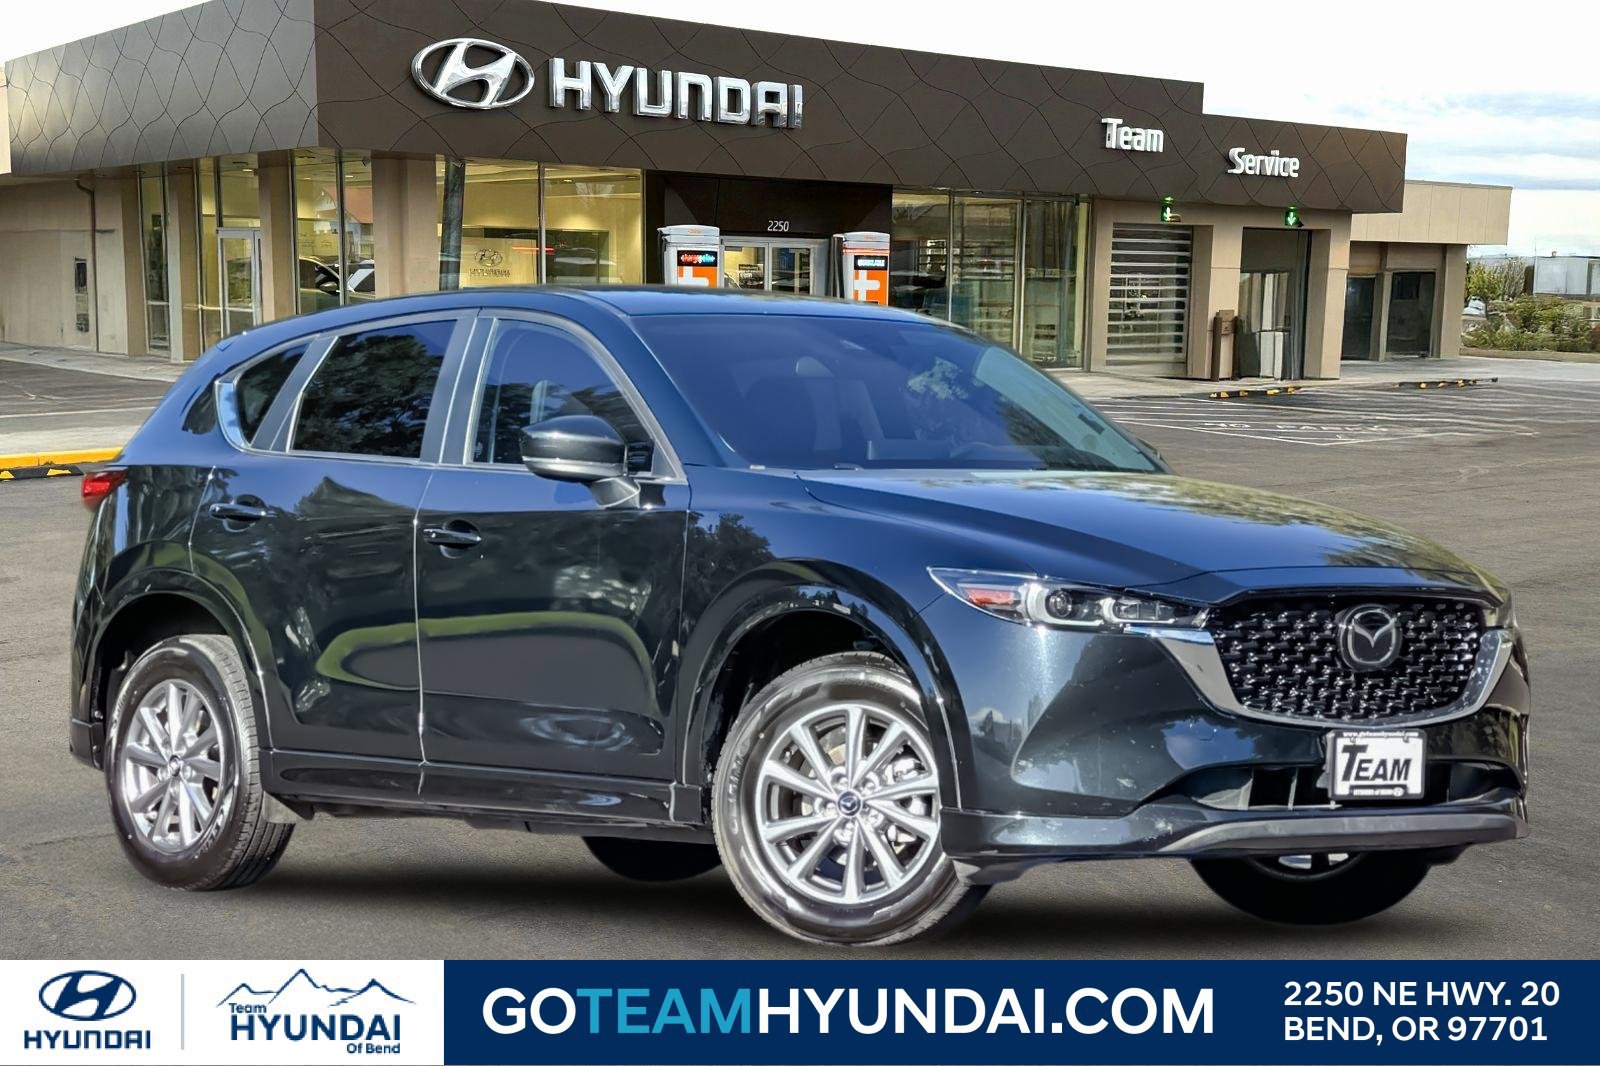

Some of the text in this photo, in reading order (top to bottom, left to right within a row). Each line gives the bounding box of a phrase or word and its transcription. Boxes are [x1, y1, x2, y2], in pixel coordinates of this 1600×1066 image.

[548, 57, 804, 129] HYUNDAI
[1101, 117, 1164, 153] Team
[1227, 147, 1300, 178] Service
[767, 220, 790, 232] 2250
[1341, 744, 1412, 782] TEAM
